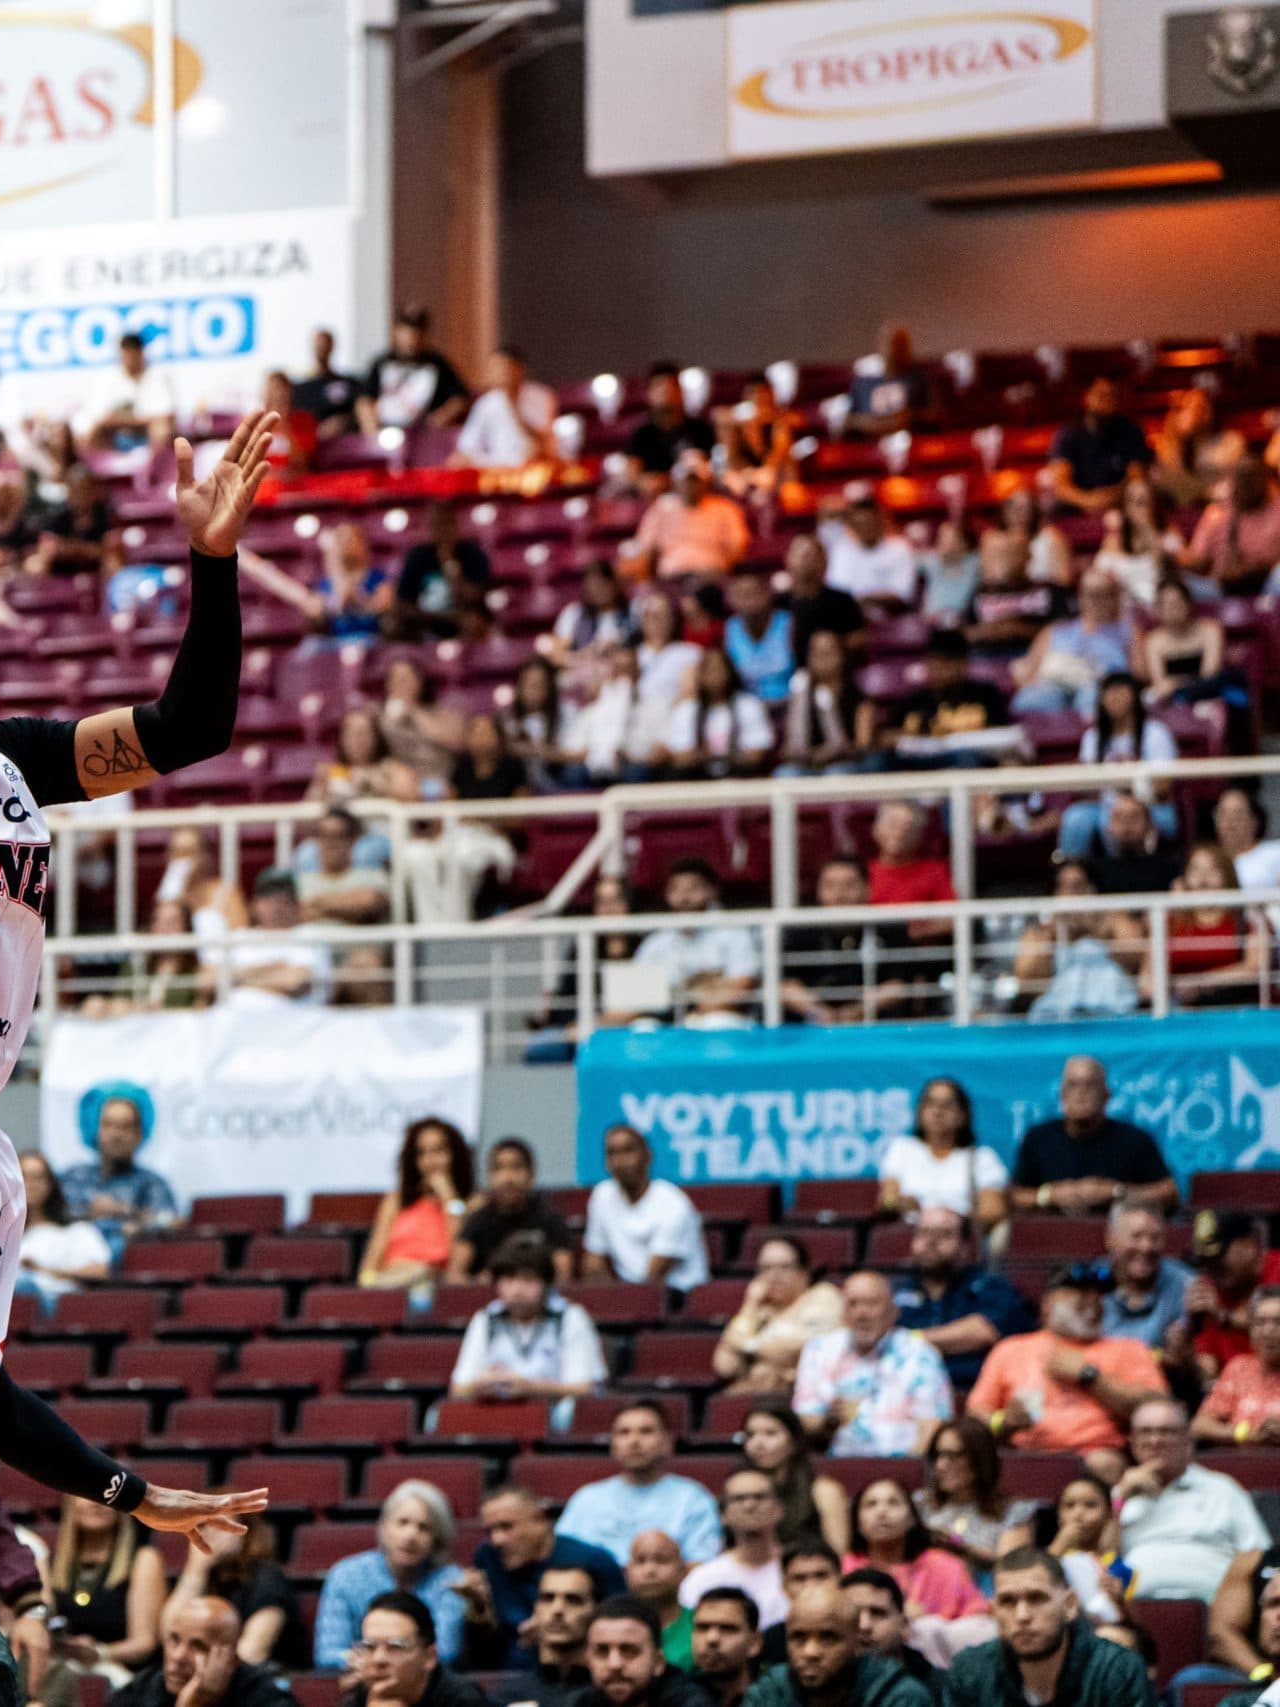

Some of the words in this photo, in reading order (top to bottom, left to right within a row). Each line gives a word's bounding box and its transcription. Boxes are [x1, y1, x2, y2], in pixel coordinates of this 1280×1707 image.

[790, 37, 1044, 94] TROPIGAS
[64, 240, 310, 292] ENERGIZA
[170, 1087, 424, 1146] CooperVisio
